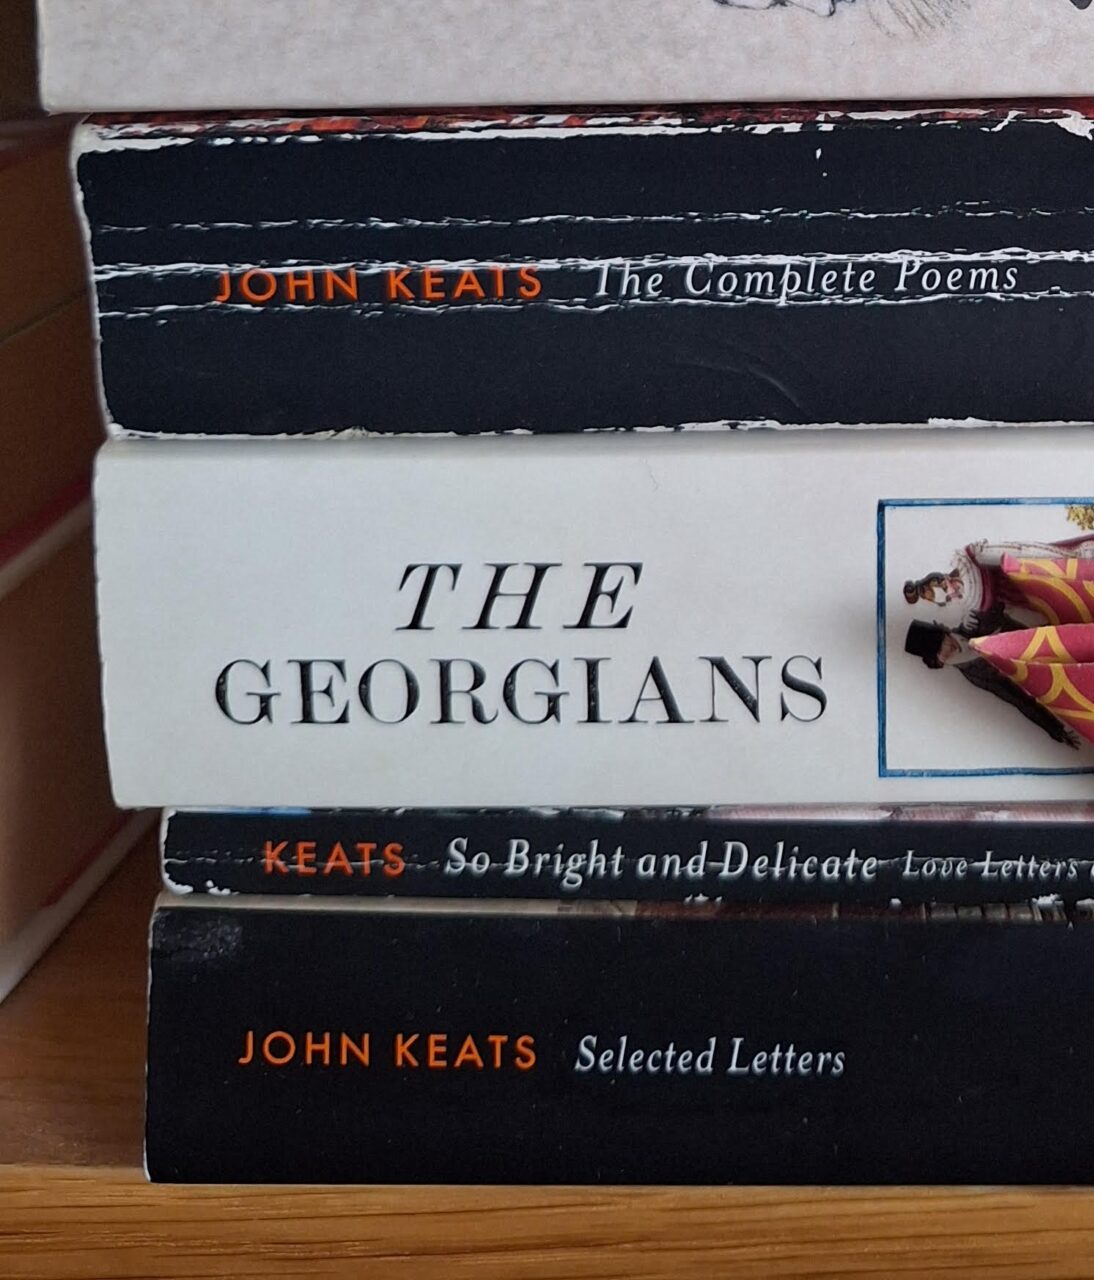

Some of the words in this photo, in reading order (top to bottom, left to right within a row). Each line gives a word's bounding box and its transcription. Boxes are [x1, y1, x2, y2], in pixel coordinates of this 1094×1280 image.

[214, 265, 358, 305] JOHN
[386, 263, 543, 301] KEATS
[596, 260, 664, 299] The
[683, 258, 876, 307] Complete
[893, 257, 1019, 293] Poems
[394, 561, 644, 632] THE
[214, 655, 828, 725] GEORGIANS
[263, 840, 406, 878] KEATS
[444, 837, 490, 876] So
[503, 838, 625, 891] Bright
[636, 840, 708, 878] and
[716, 840, 880, 881] Delicate
[903, 848, 969, 880] Love
[979, 849, 1079, 881] Letters
[238, 1030, 370, 1067] JOHN
[394, 1033, 537, 1071] KEATS
[573, 1034, 714, 1075] Selected
[727, 1036, 847, 1075] Letters
